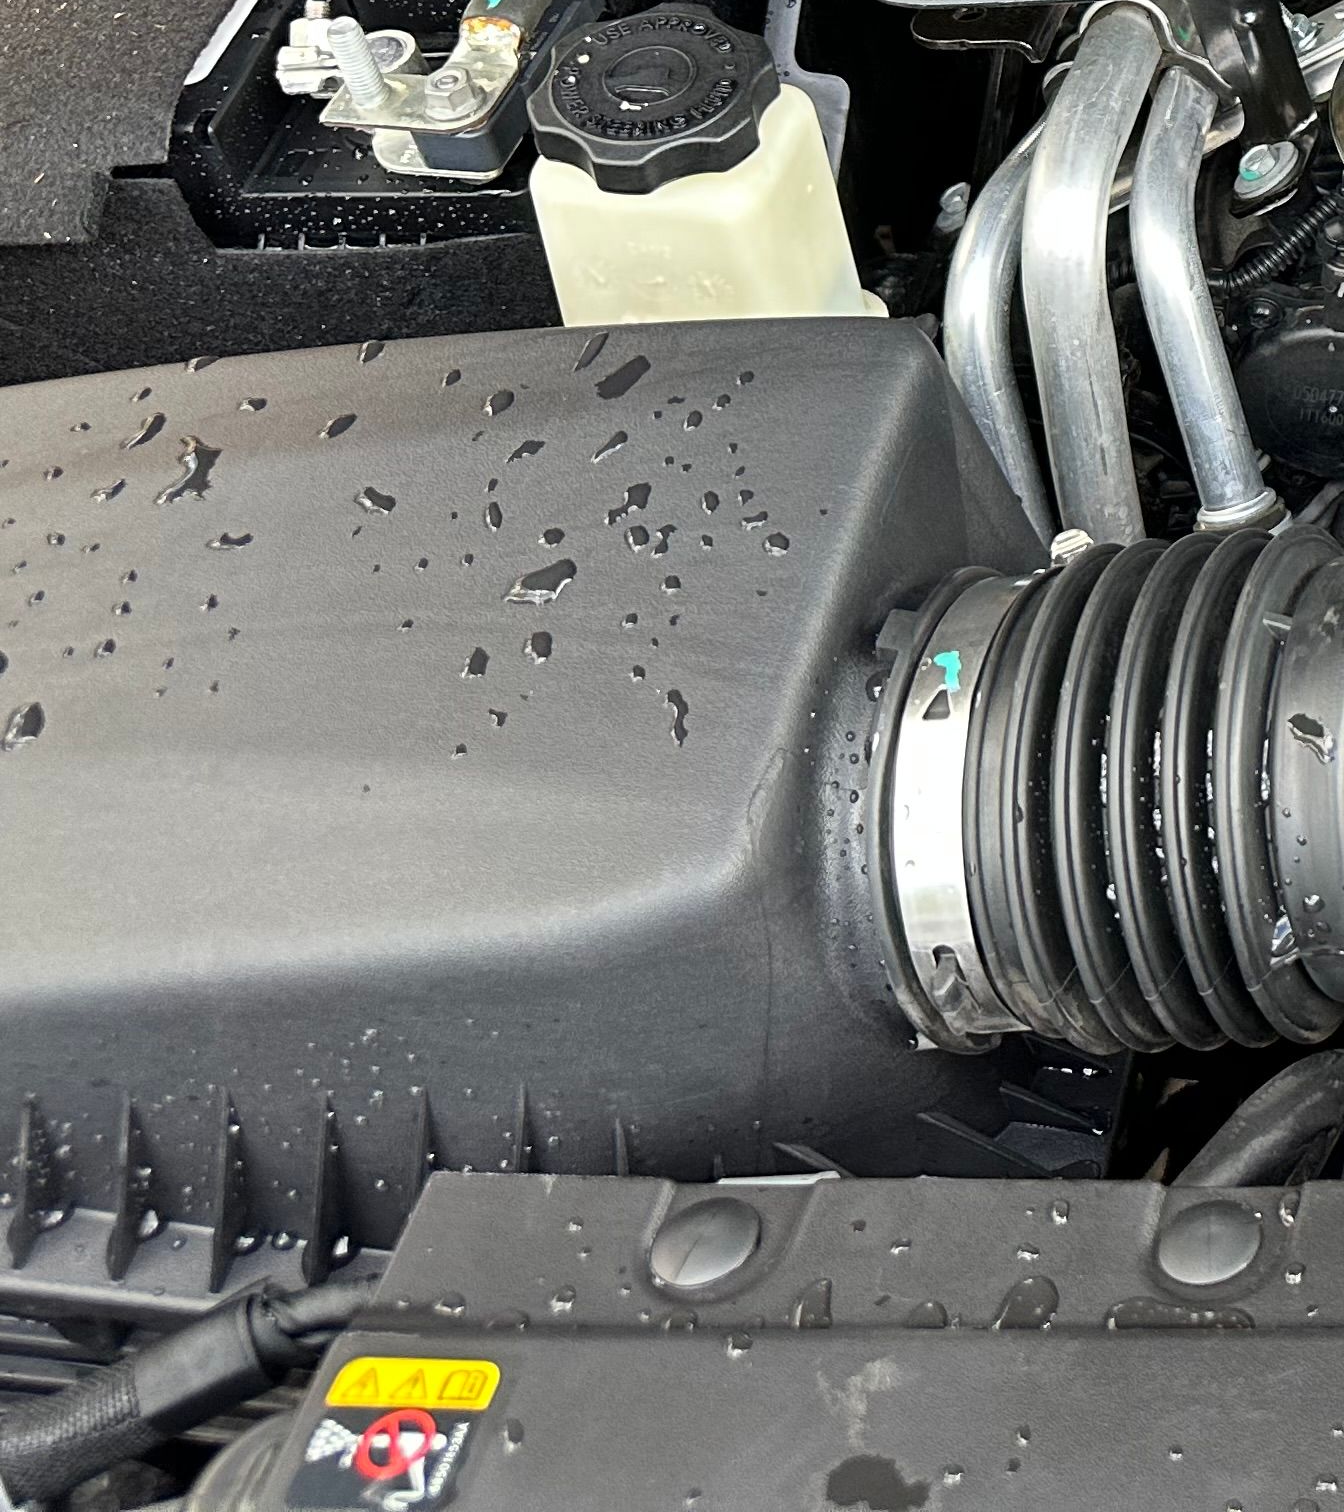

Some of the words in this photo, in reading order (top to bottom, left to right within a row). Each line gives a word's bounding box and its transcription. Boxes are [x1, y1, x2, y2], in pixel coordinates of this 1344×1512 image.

[592, 23, 632, 45] USE
[638, 15, 735, 54] APPROVED
[584, 113, 690, 137] STEERING
